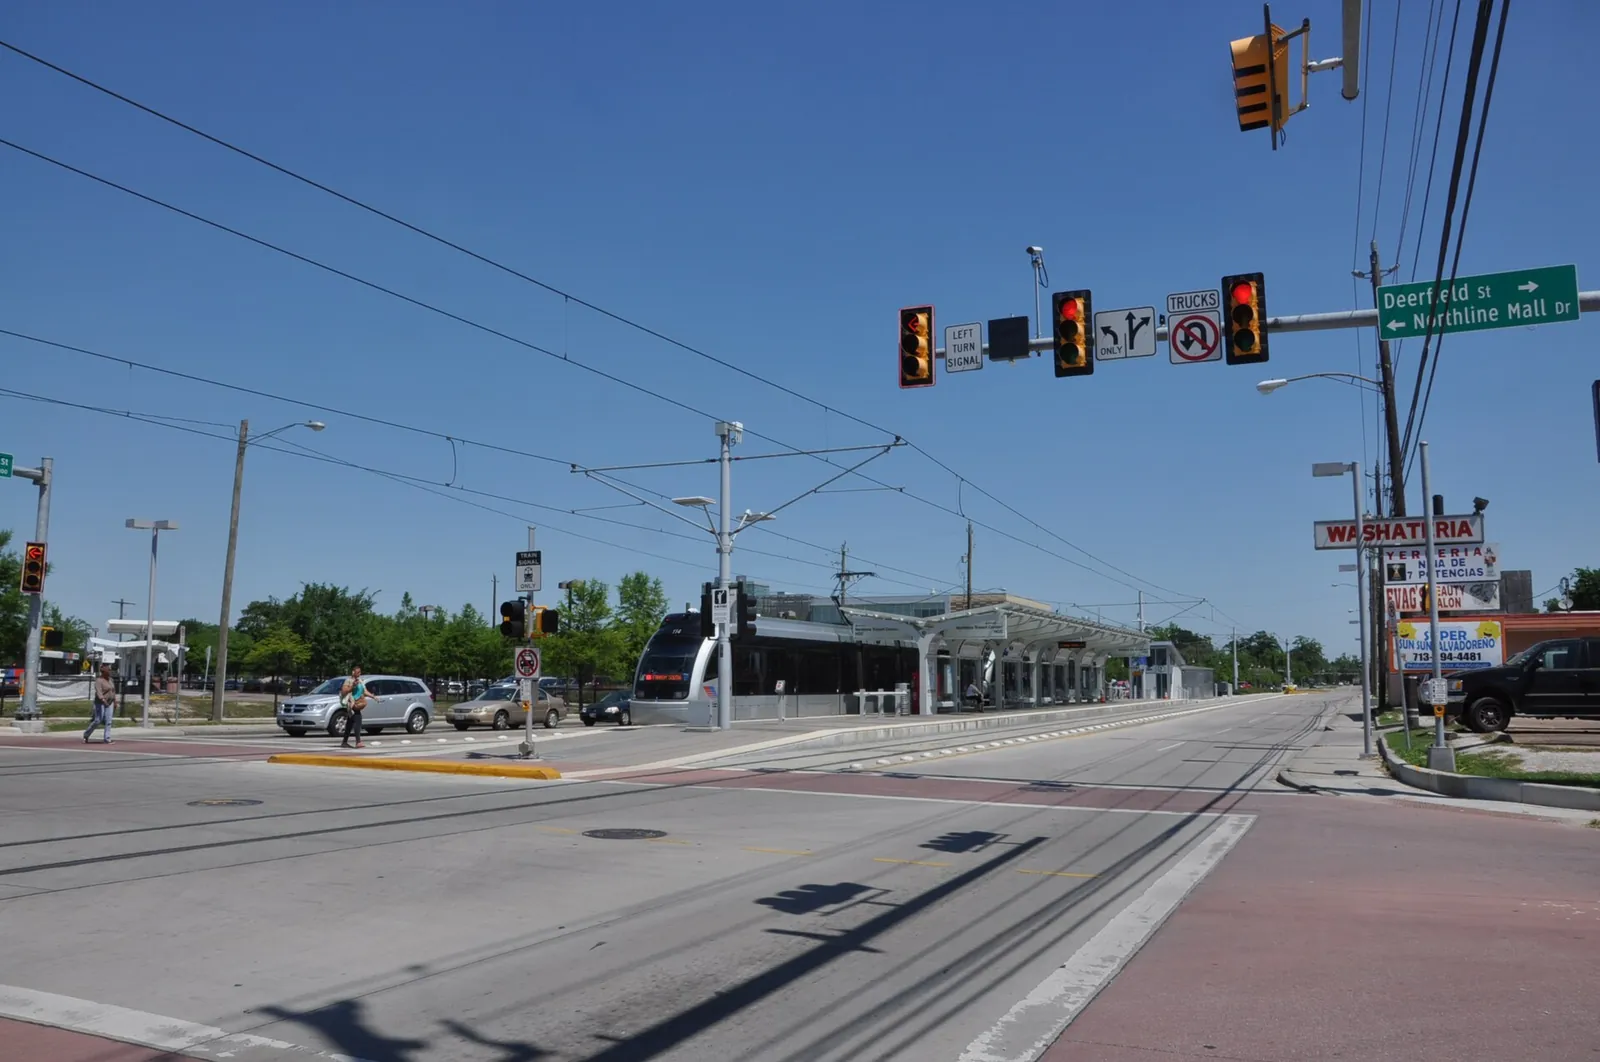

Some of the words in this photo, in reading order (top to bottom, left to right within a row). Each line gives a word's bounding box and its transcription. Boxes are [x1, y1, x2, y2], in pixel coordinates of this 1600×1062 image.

[1170, 293, 1217, 310] TRUCKS
[1384, 283, 1469, 309] Deerfeld
[1477, 285, 1491, 299] St
[1413, 306, 1499, 330] Northline
[1507, 299, 1547, 320] Mall
[1555, 301, 1571, 315] Dr
[952, 329, 973, 340] LEFT
[952, 342, 975, 353] TURN
[1100, 345, 1122, 356] ONLY
[947, 355, 980, 368] SIGNAL
[520, 552, 538, 560] TRAIN
[1386, 547, 1482, 561] YERERIA
[1451, 558, 1466, 567] DE
[1407, 571, 1413, 580] 7
[1437, 597, 1462, 608] ALON
[1424, 630, 1467, 641] SPER
[1399, 638, 1417, 650] SUN
[1439, 636, 1496, 652] ALVADOREÑO
[1413, 652, 1482, 662] 713-94-4481
